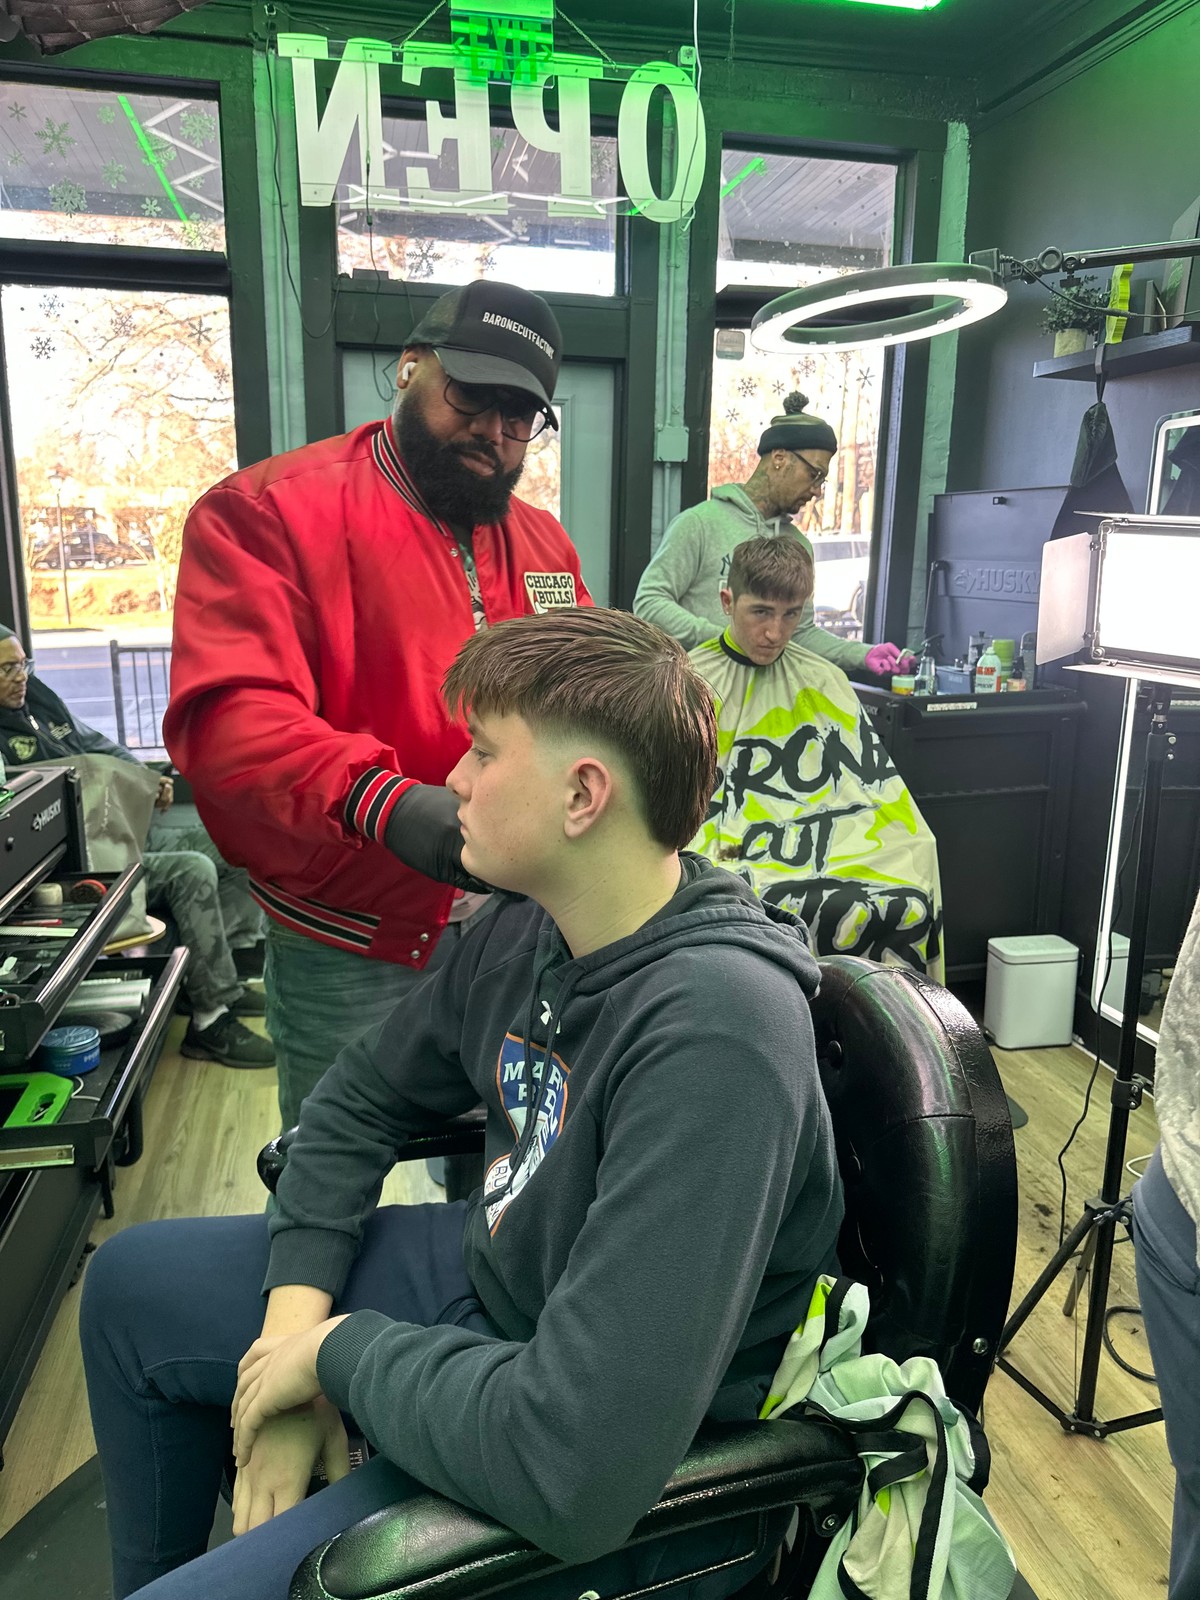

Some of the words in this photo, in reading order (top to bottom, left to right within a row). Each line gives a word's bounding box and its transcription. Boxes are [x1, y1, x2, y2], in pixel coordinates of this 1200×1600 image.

[468, 16, 538, 82] EXIT
[526, 574, 573, 589] CHICAGO
[976, 567, 1041, 595] HUSKY
[539, 590, 575, 605] BULLS
[40, 799, 62, 826] HUSKY
